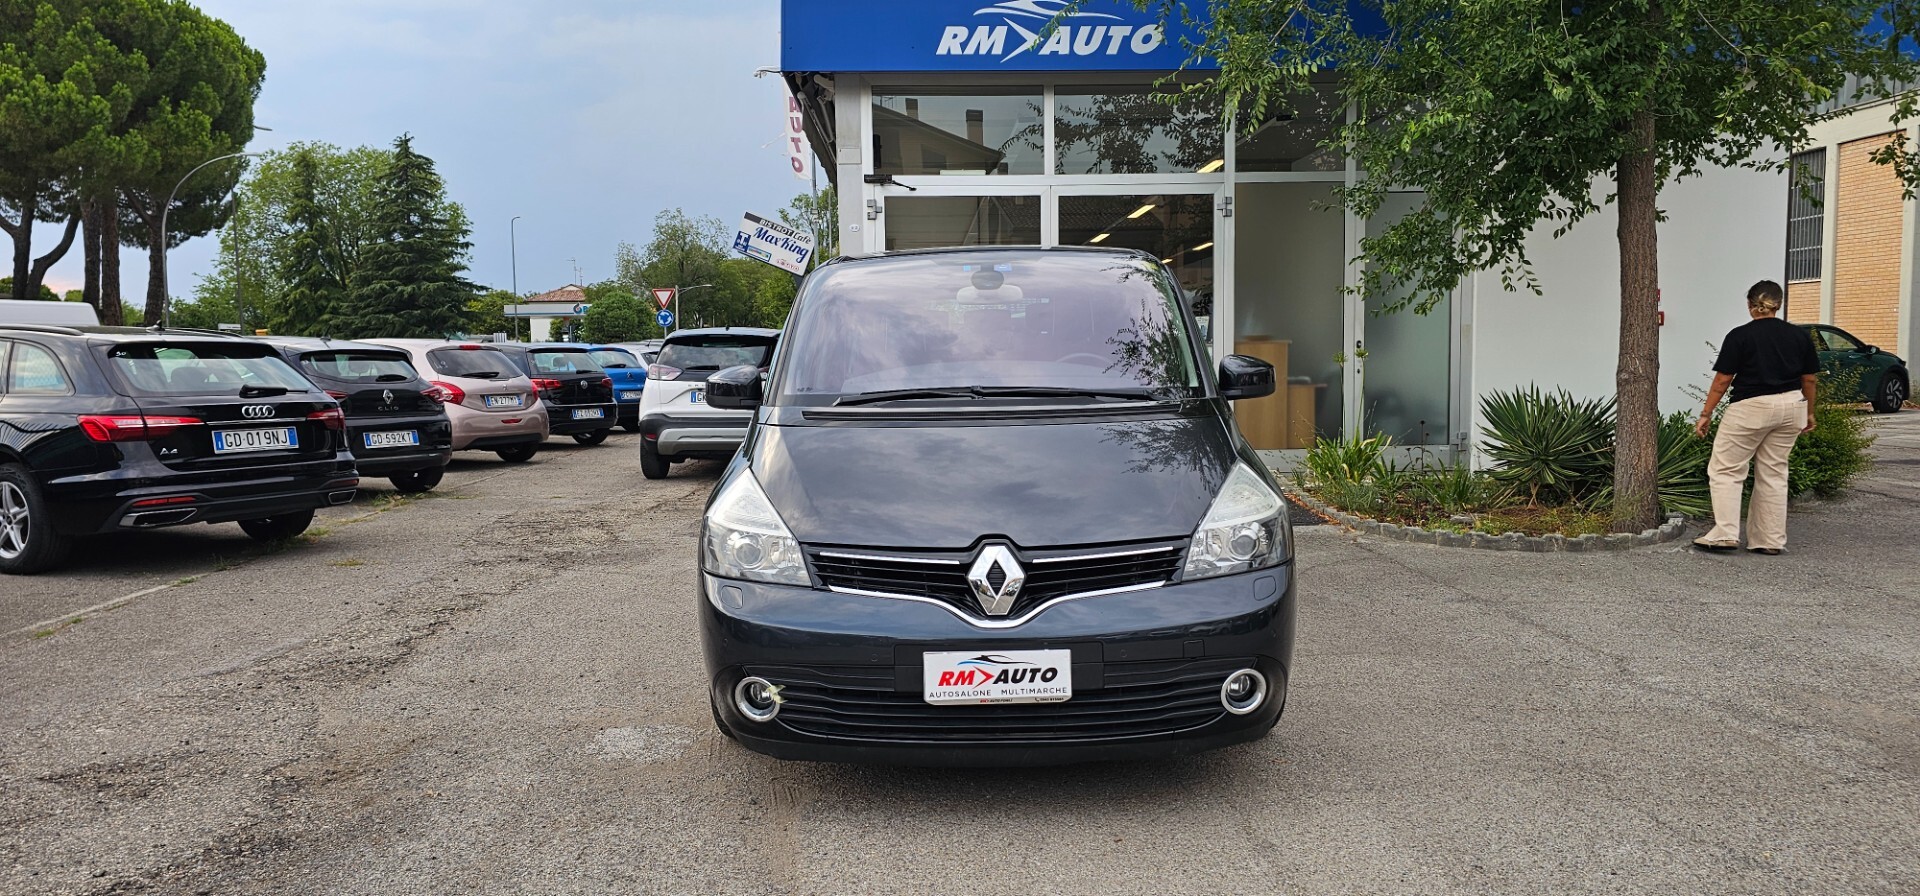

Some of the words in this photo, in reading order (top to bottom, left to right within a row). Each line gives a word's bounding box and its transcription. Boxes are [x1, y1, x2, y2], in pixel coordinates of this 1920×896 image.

[936, 25, 1008, 55] RM
[1038, 24, 1164, 56] AUTO
[760, 218, 793, 236] BISTROT
[160, 447, 178, 456] A4
[938, 670, 975, 687] RM
[992, 667, 1058, 685] AUTO
[929, 689, 991, 698] AUTOSALONE
[1001, 687, 1068, 696] MULTIMARCHE
